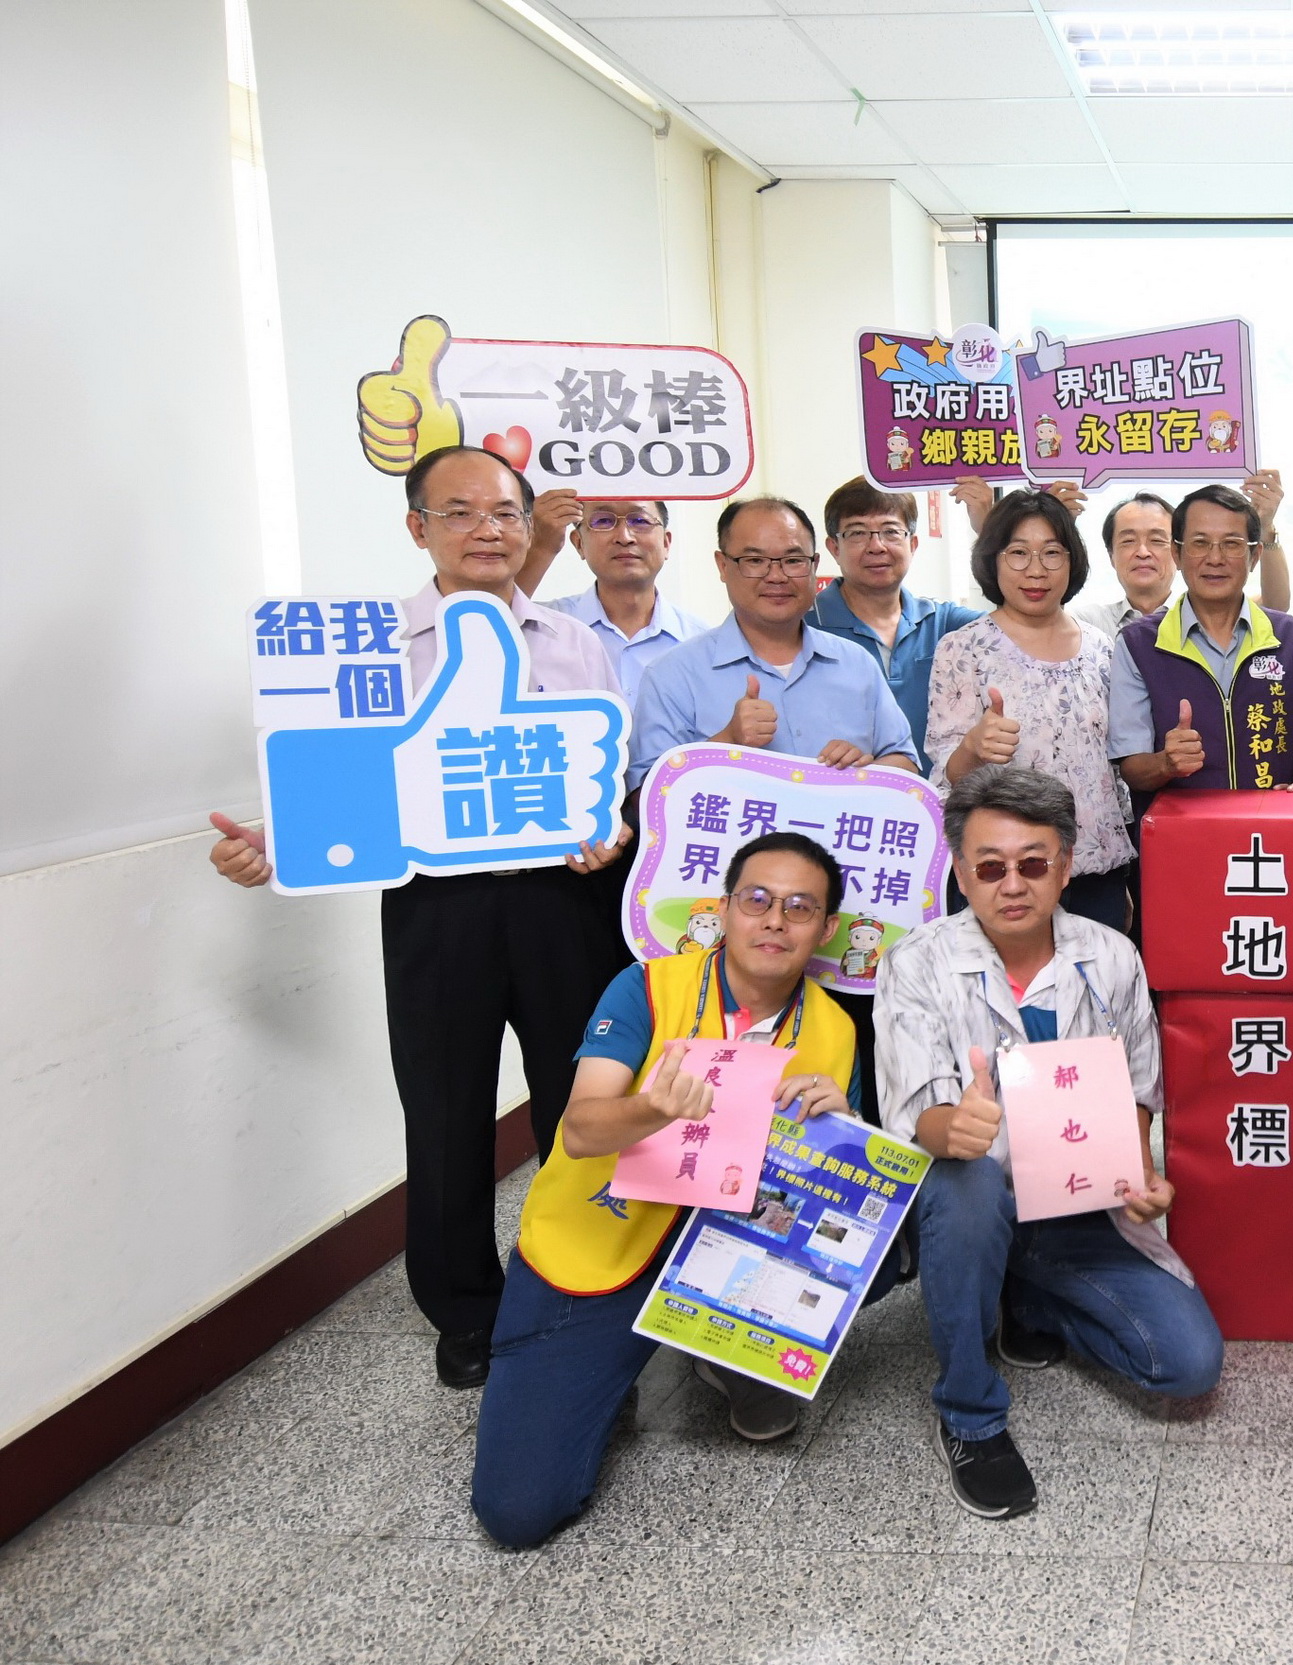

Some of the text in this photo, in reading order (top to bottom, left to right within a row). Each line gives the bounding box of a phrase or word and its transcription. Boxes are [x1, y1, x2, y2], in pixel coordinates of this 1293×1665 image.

[460, 367, 728, 435] 一級棒
[893, 382, 1016, 420] 政府用
[1055, 351, 1224, 408] 界址點位
[538, 440, 731, 477] GOOD
[1078, 409, 1202, 455] 永留存
[254, 600, 401, 656] 給我
[259, 663, 406, 718] 一個
[1269, 681, 1288, 754] 地政處長
[1246, 703, 1274, 789] 蔡和昌
[436, 723, 573, 840] 讚
[686, 791, 920, 859] 鑑界一把照
[1226, 836, 1289, 1164] 土地界標
[880, 1146, 920, 1168] 113.07.01
[1053, 1065, 1092, 1195] 郝也仁
